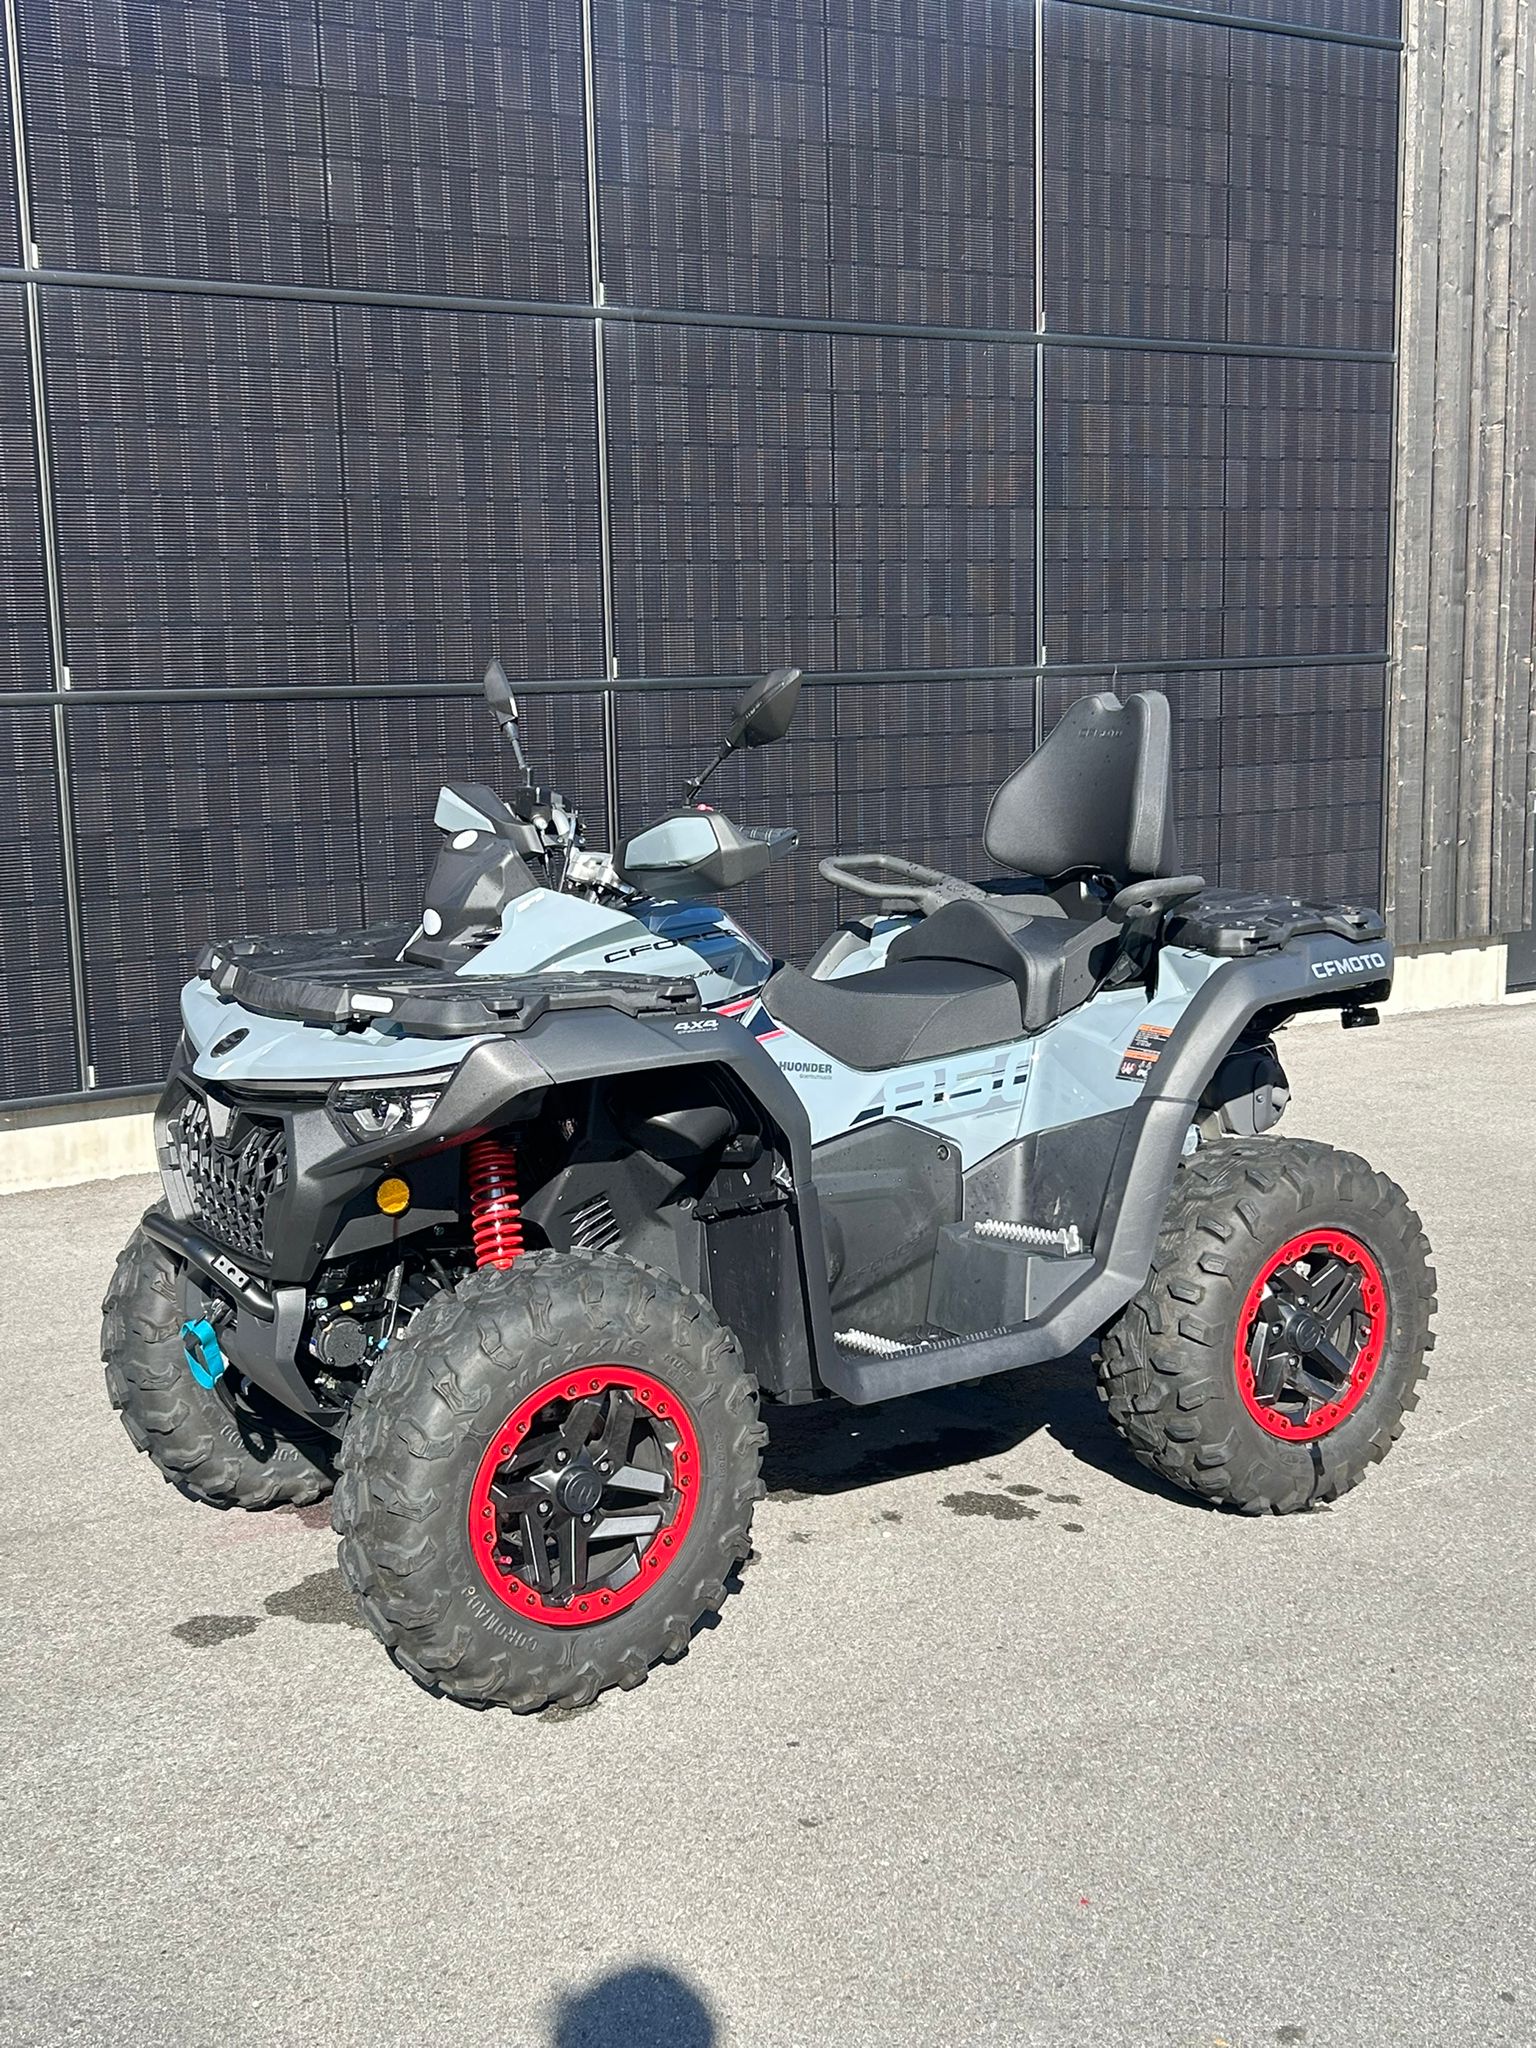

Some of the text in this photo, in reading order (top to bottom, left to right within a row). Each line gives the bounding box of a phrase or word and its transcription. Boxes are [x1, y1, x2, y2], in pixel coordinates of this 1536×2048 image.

[604, 929, 738, 963] CFORCE
[1310, 952, 1386, 979] CFMOTO
[779, 1061, 833, 1074] HUONDER
